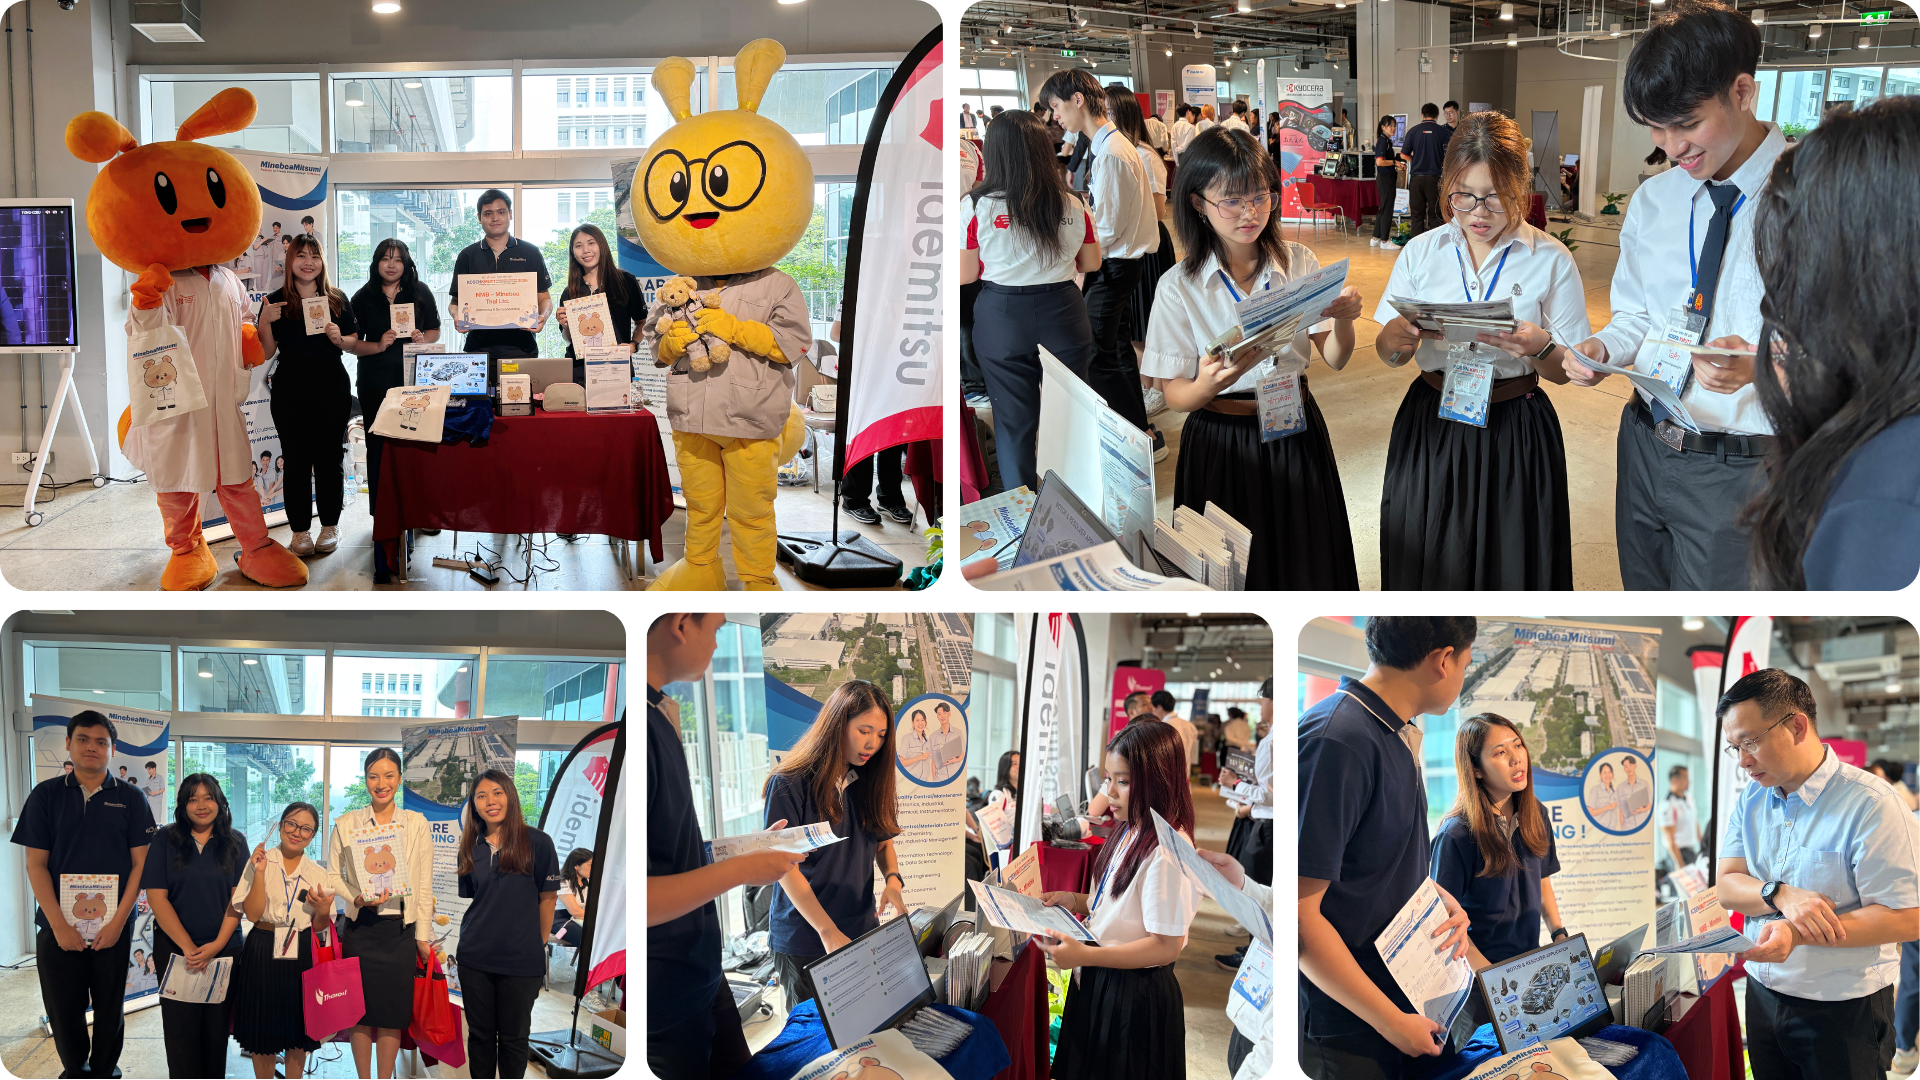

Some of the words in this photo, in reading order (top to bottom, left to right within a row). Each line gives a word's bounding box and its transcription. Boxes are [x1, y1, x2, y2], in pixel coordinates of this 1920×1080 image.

[1514, 628, 1615, 646] MinebeaMitsumi
[109, 712, 164, 726] MinebeaMitsumi
[428, 725, 486, 735] MinebeaMitsumi
[798, 1038, 874, 1080] MinebeaMitsumi
[1469, 1045, 1548, 1080] MinebeaMitsumi
